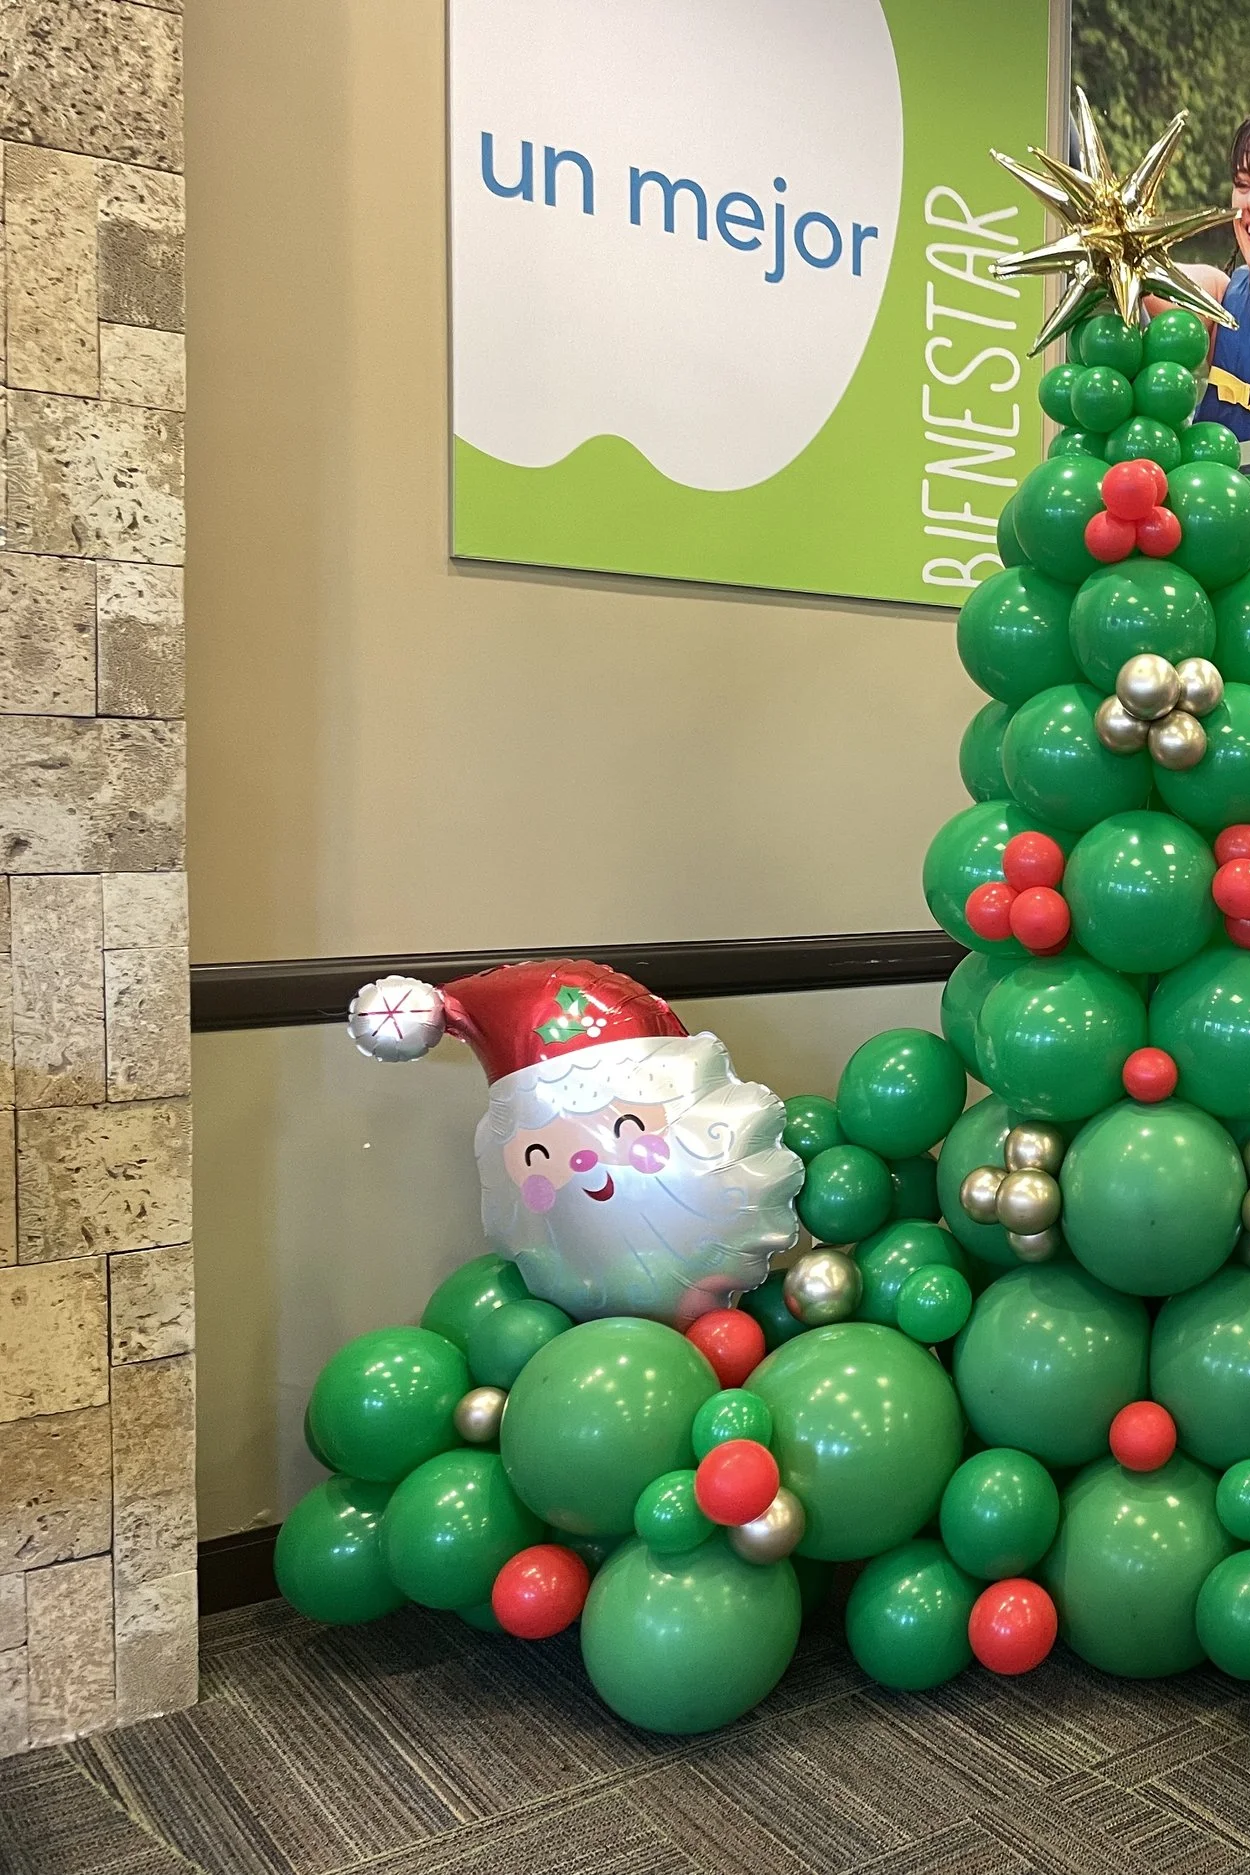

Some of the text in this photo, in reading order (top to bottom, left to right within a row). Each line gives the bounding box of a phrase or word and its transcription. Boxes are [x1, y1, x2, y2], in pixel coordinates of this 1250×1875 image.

[481, 131, 878, 283] un mejor
[922, 185, 1021, 587] BIENESTAR
